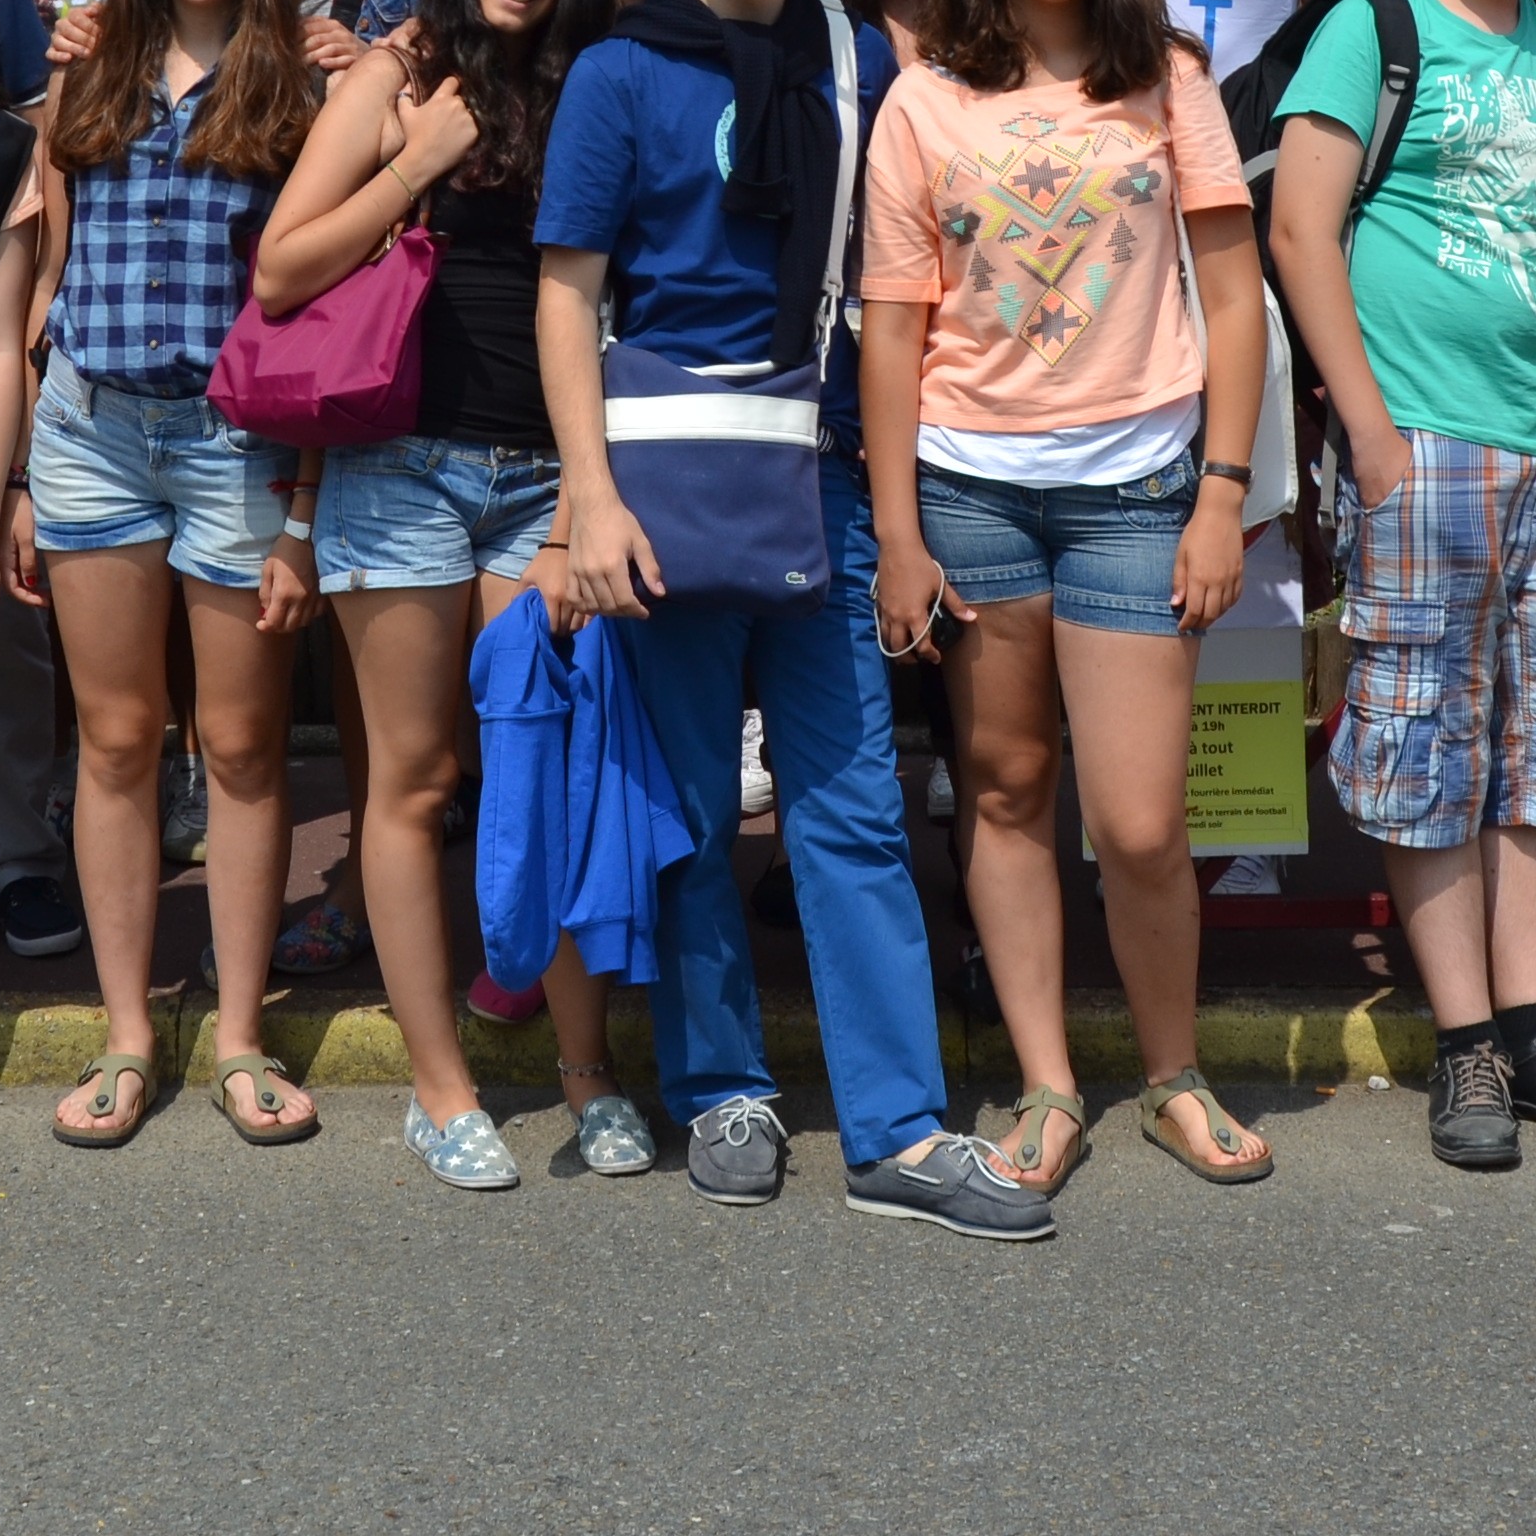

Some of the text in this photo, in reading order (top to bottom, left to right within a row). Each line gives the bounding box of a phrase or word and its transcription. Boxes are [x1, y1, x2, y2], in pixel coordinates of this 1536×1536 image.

[1432, 103, 1496, 144] Blue
[1191, 702, 1281, 716] ENT INTERDIT
[1191, 721, 1225, 732] à 19h
[1189, 740, 1234, 755] à tout
[1186, 763, 1224, 778] uillet
[1191, 787, 1274, 797] fourrière immédiat
[1205, 809, 1213, 817] le
[1215, 808, 1242, 817] terrain
[1244, 808, 1253, 816] de
[1256, 807, 1287, 816] football
[1186, 821, 1222, 829] medi soir
